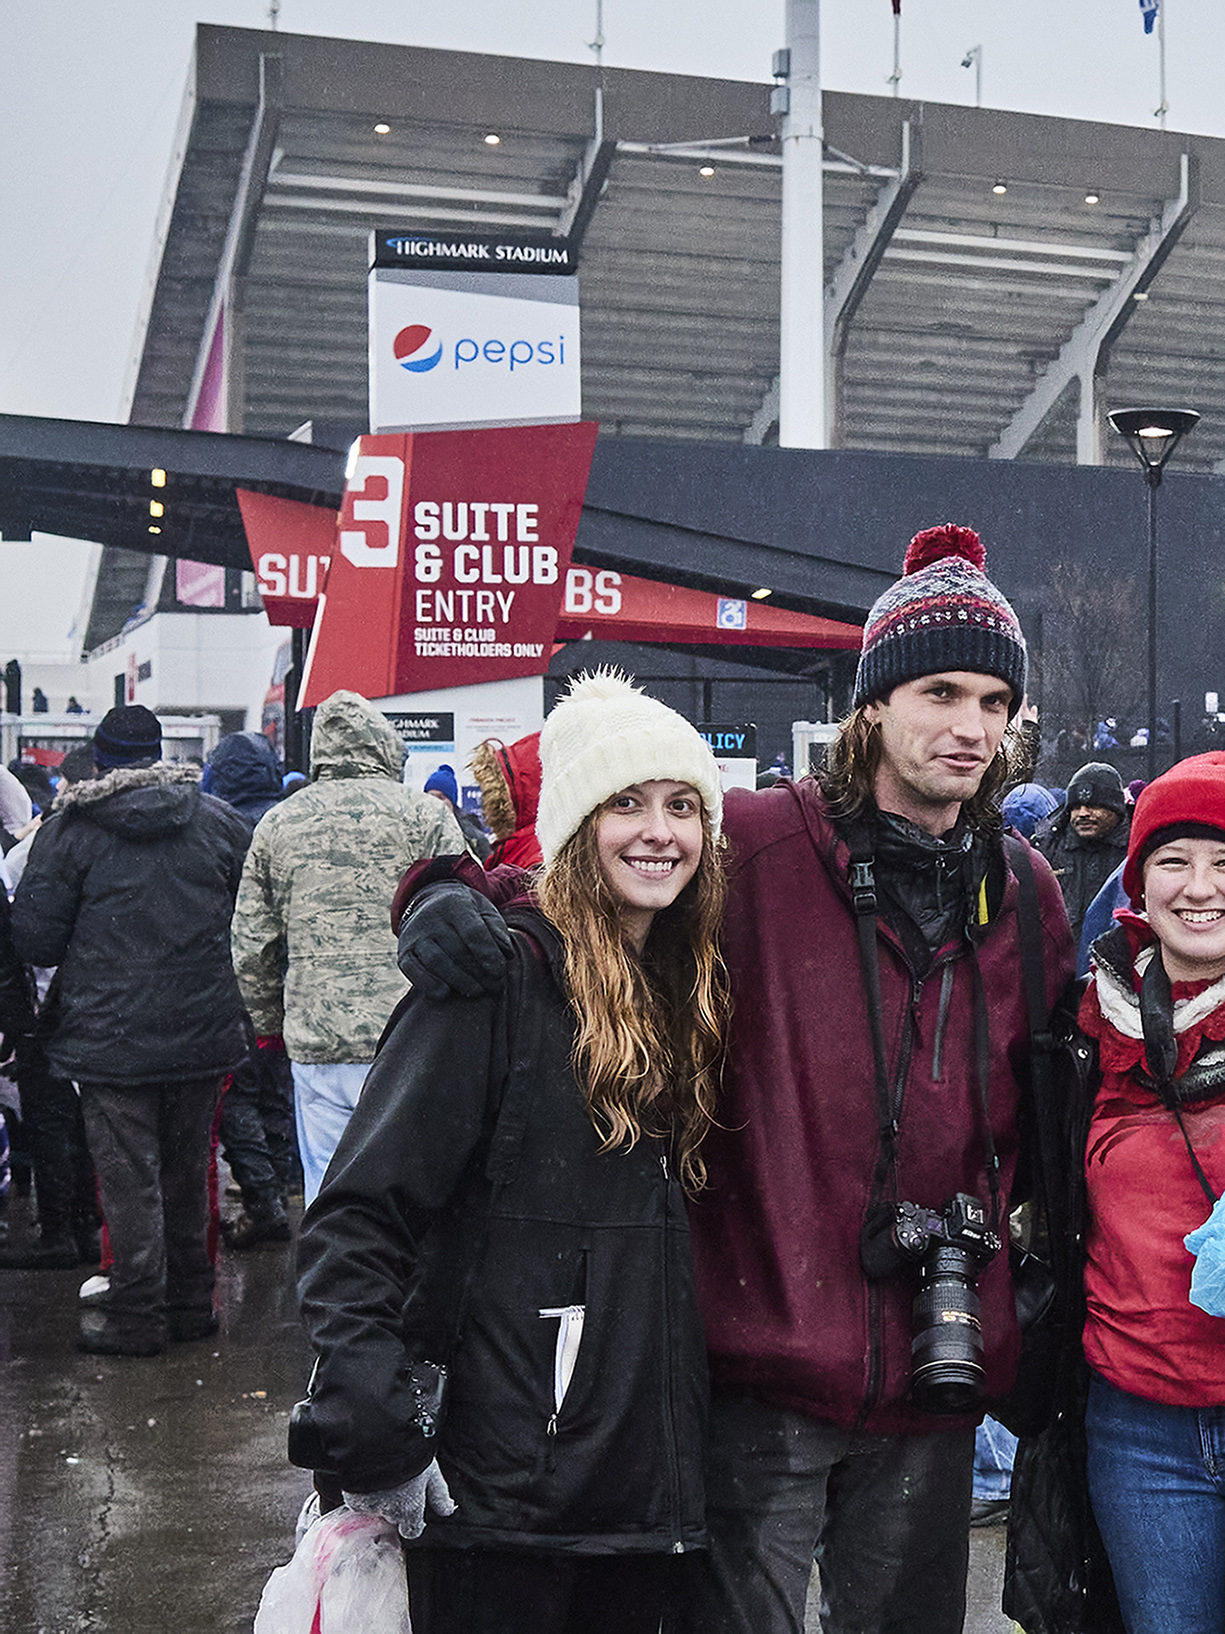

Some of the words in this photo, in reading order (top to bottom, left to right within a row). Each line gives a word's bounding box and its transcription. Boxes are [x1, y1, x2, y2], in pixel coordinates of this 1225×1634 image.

[396, 240, 490, 259] HIGHMARK
[495, 245, 569, 264] STADIUM
[454, 335, 565, 371] pepsi
[341, 456, 405, 568] 3
[414, 501, 539, 542] SUITE
[415, 544, 443, 583] &
[454, 545, 559, 585] CLUB
[415, 590, 515, 623] ENTRY
[414, 628, 450, 641] SUITE
[453, 628, 462, 641] &
[464, 628, 496, 641] CLUB
[415, 643, 512, 657] TICKETHOLDERS
[514, 643, 543, 657] ONLY
